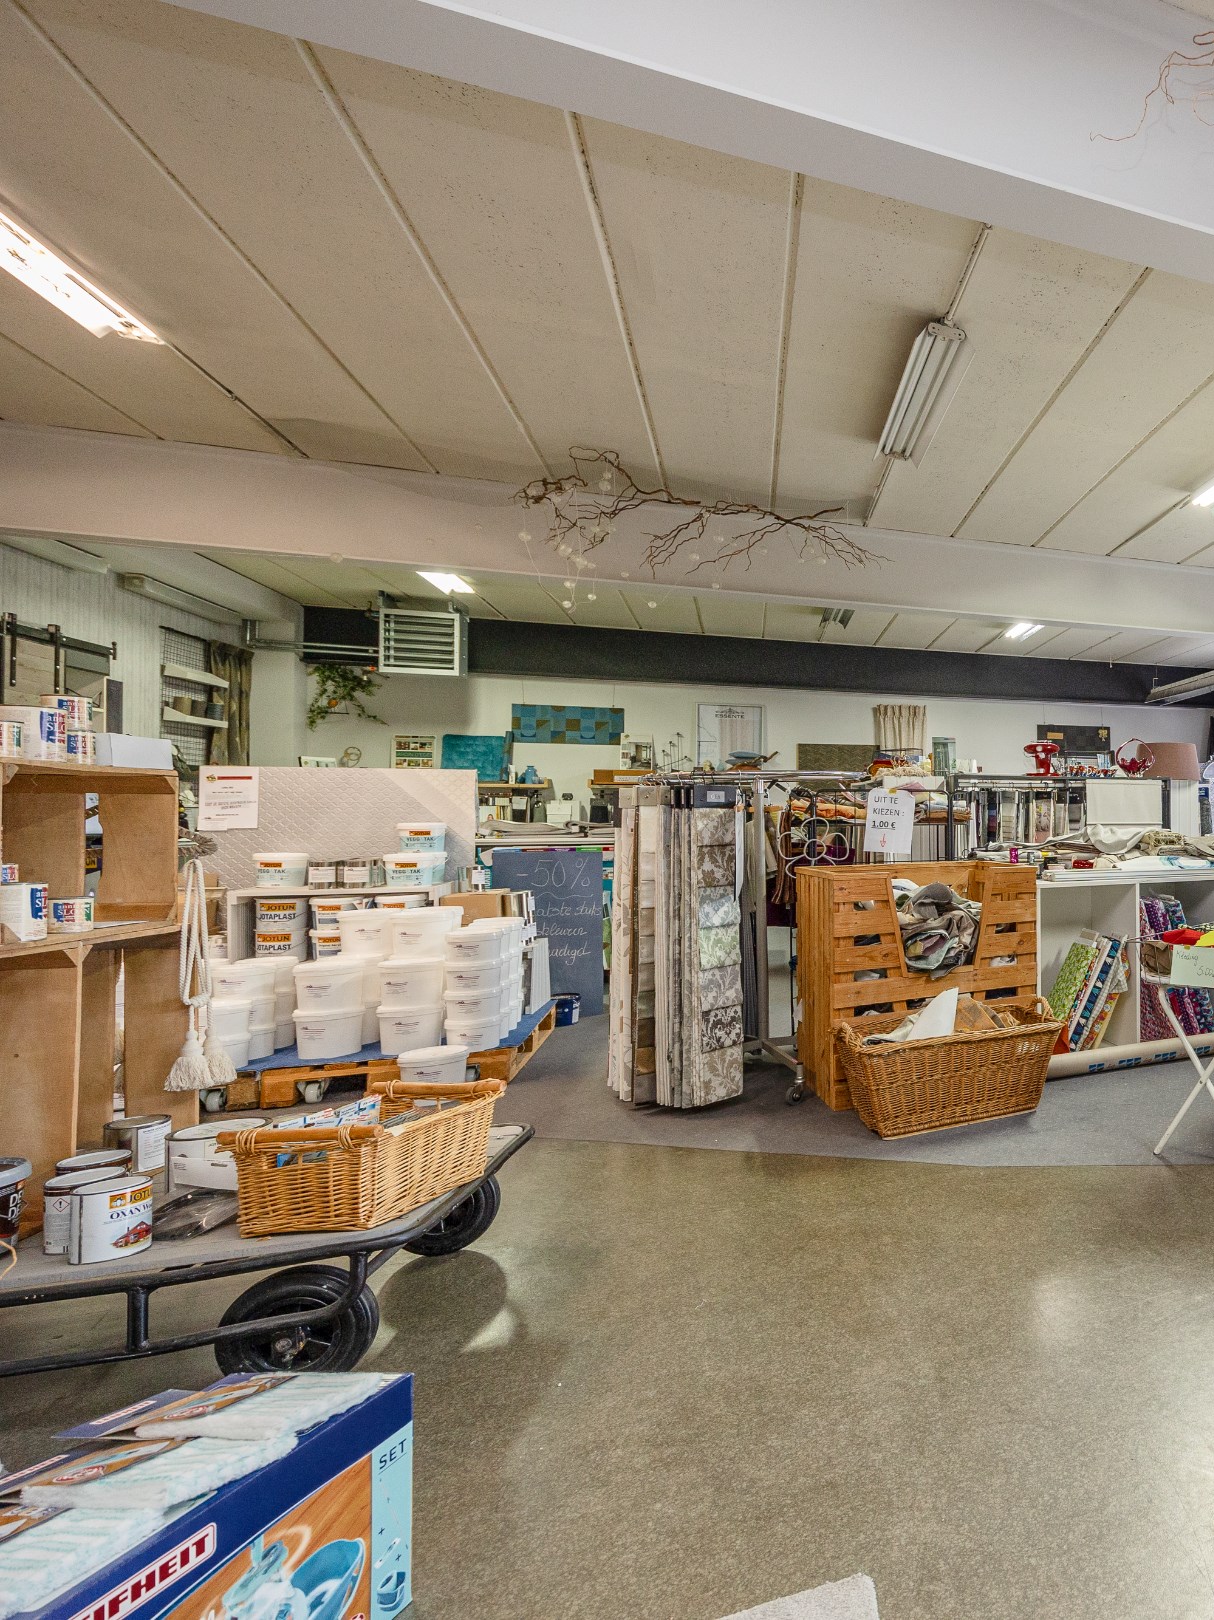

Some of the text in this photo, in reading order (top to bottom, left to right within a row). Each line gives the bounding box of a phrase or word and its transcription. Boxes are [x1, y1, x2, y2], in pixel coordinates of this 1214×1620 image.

[873, 796, 899, 805] UIT TE
[872, 807, 900, 817] KIEZEN
[261, 934, 291, 942] JOTUN
[109, 1207, 141, 1221] OXAN
[379, 1438, 408, 1471] SET
